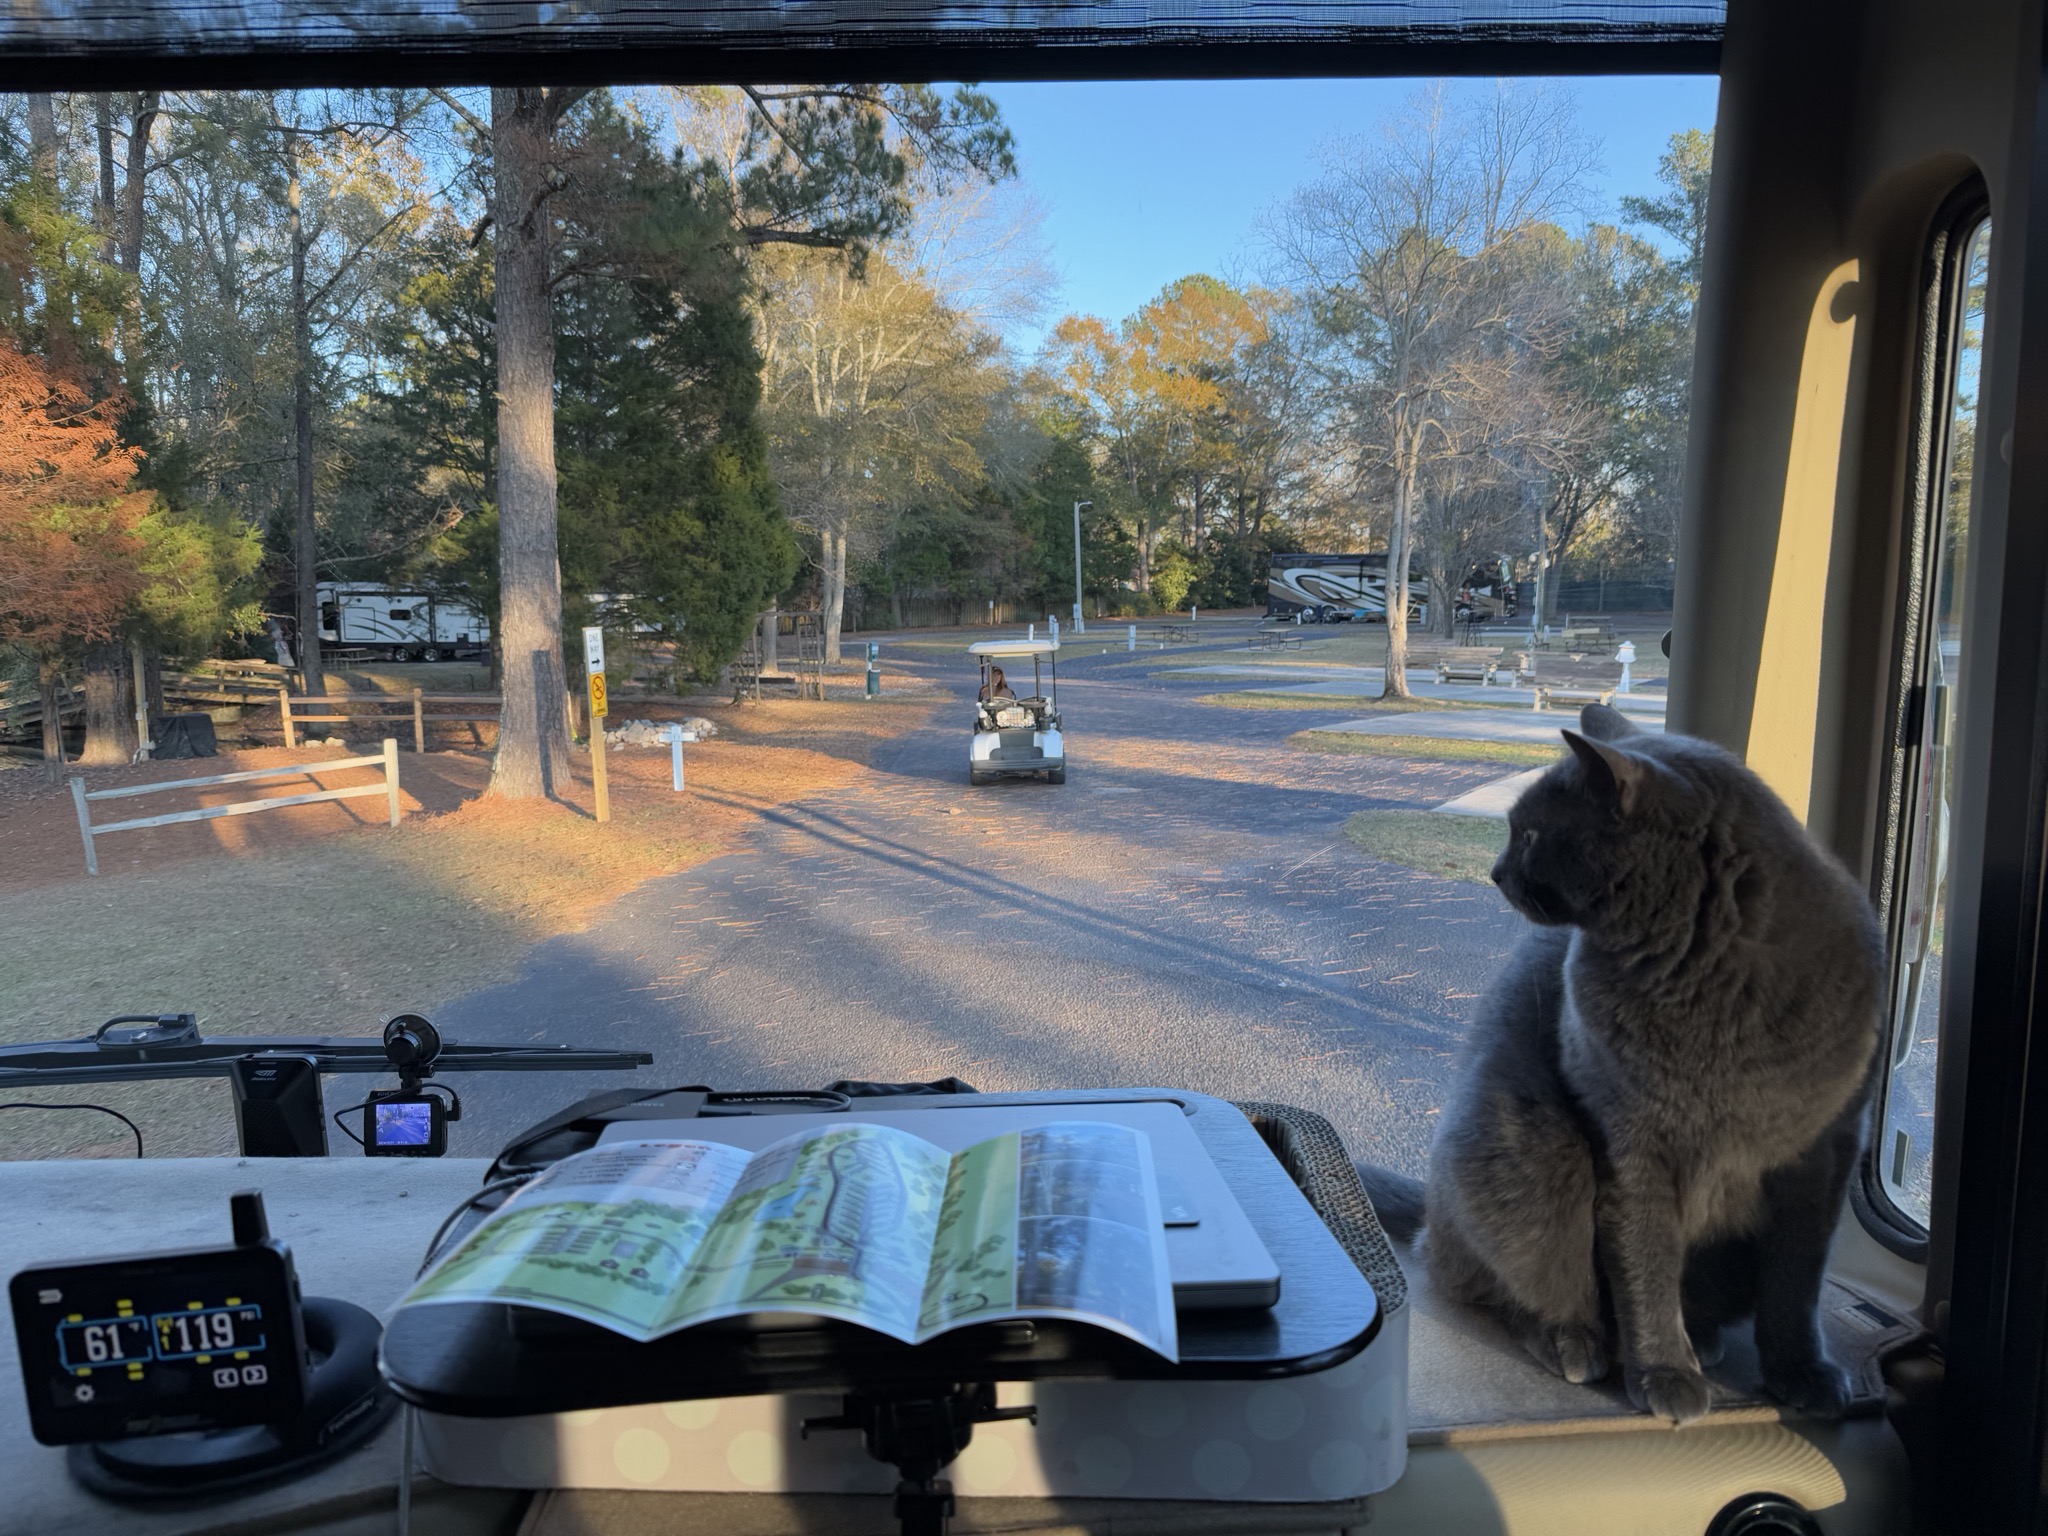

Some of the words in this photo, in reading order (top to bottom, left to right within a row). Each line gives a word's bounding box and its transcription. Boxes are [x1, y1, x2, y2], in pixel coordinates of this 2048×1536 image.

[588, 633, 599, 642] ONE
[589, 644, 600, 654] WAY
[84, 1324, 124, 1362] 61
[175, 1312, 235, 1352] 119
